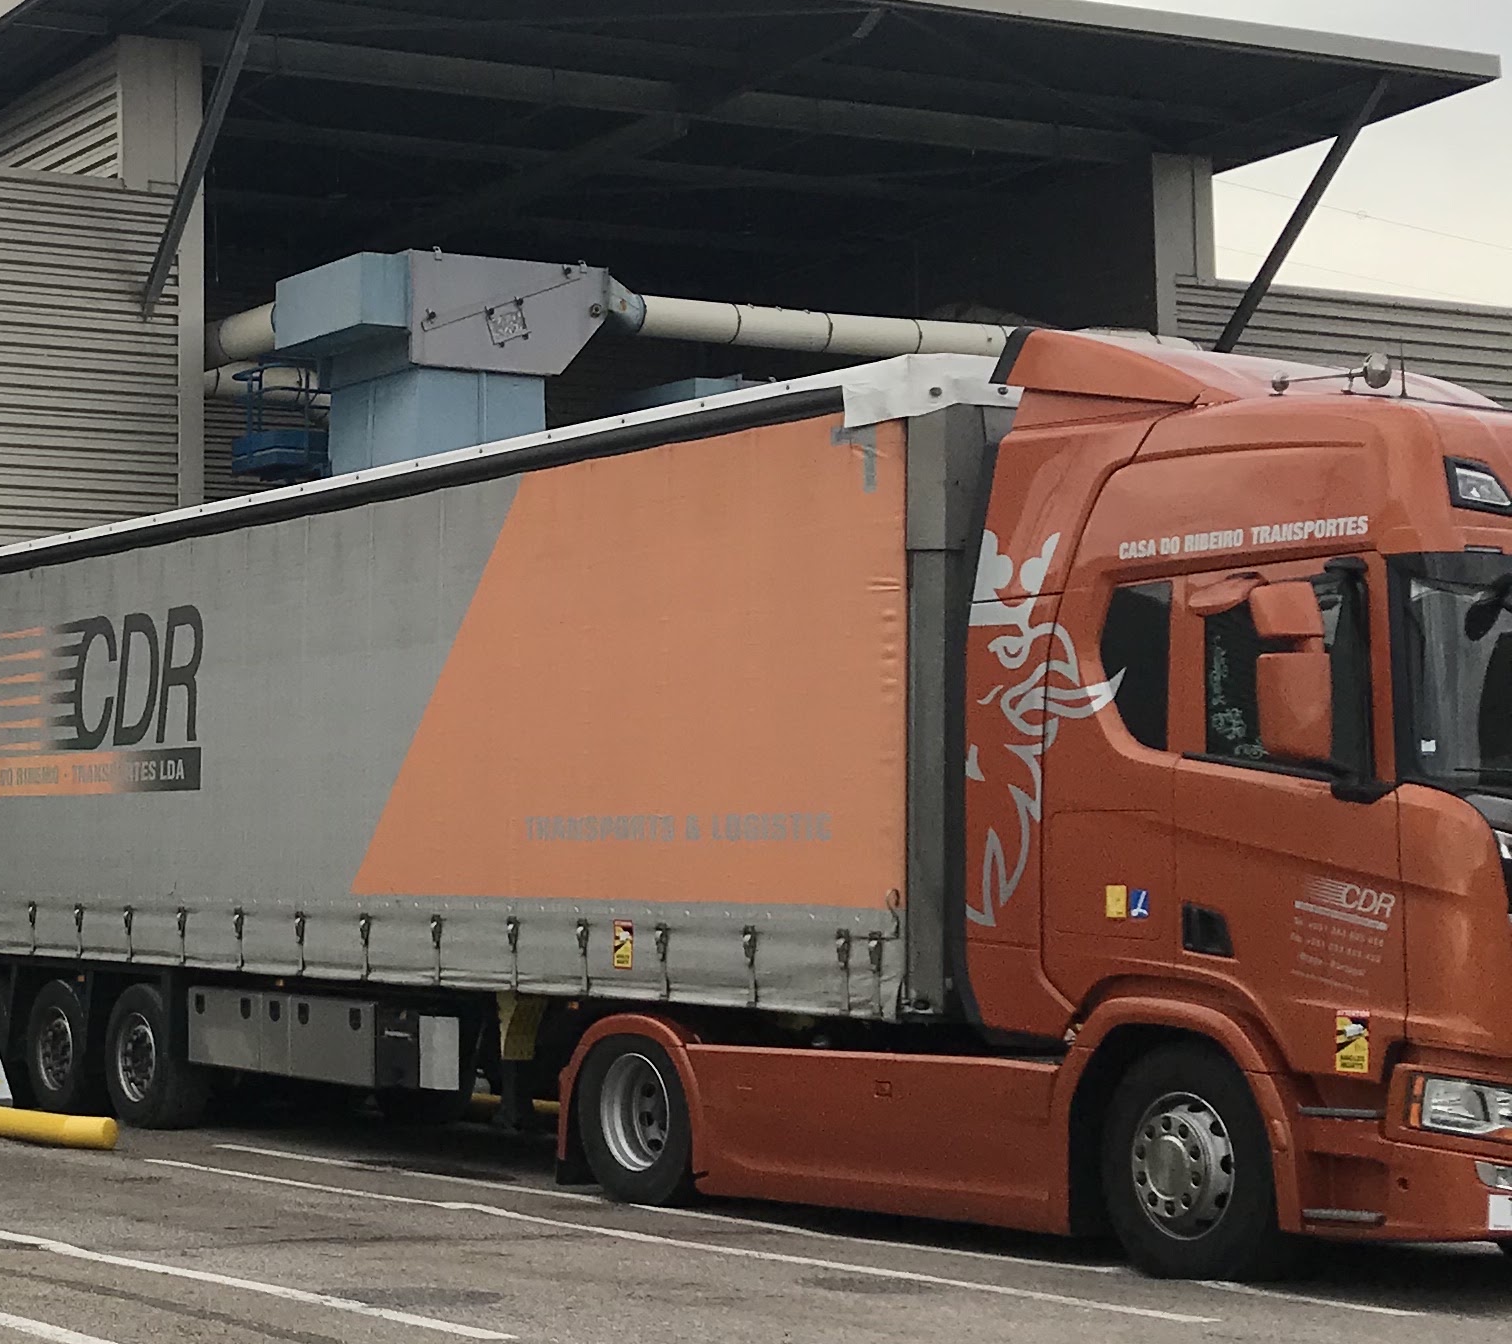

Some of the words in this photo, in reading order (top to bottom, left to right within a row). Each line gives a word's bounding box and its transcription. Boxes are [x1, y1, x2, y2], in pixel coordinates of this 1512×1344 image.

[1119, 539, 1156, 559] CASA
[1160, 536, 1180, 554] DO
[1184, 529, 1244, 552] RIBEIRO
[1252, 515, 1369, 545] TRANSPORTES
[60, 605, 204, 750] CDR
[72, 760, 157, 784] TRANSRTES
[159, 759, 185, 781] LDA
[712, 813, 833, 842] LOGISTIC
[1339, 883, 1397, 918] CDR
